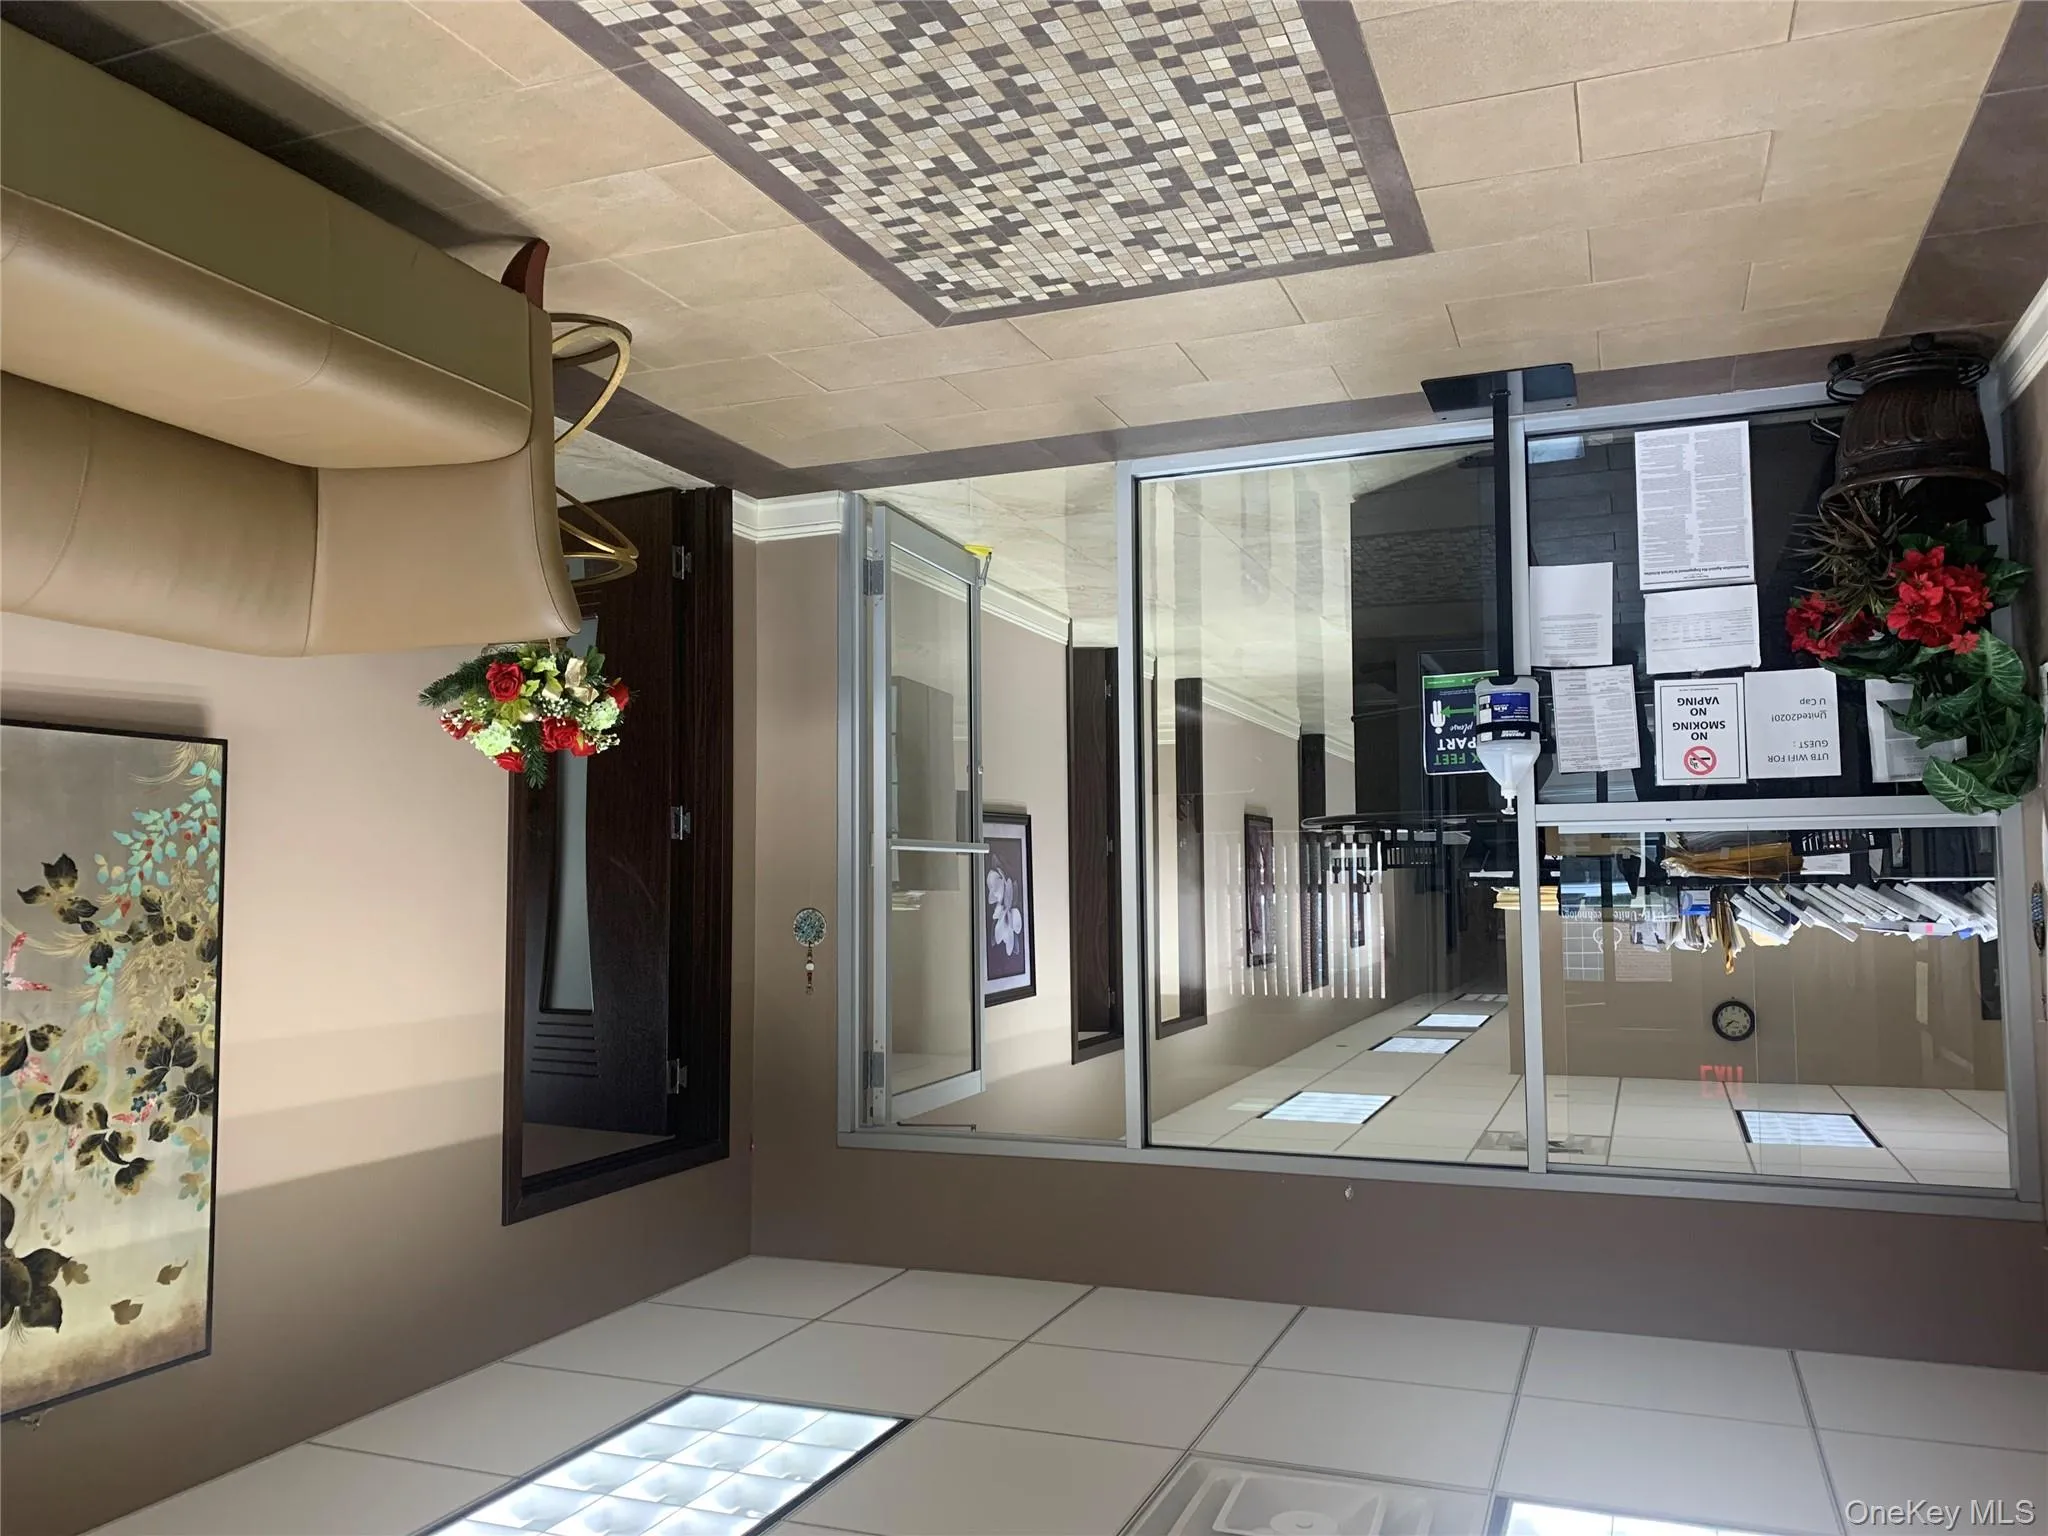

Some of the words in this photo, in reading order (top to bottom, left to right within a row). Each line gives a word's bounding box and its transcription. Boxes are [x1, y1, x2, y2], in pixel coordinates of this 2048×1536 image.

[1676, 696, 1720, 707] VAPING
[1799, 697, 1817, 706] Cap
[1690, 707, 1707, 716] NO
[1771, 711, 1827, 722] United2020!
[1449, 721, 1474, 734] please
[1672, 720, 1726, 731] SMOKING
[1691, 731, 1708, 741] NO
[1437, 736, 1477, 751] PART
[1798, 739, 1829, 749] GUEST
[1433, 753, 1466, 765] FEET
[1767, 754, 1785, 763] FOR
[1787, 753, 1808, 762] WIFI
[1810, 752, 1829, 762] UTB
[1561, 908, 1602, 922] echnology
